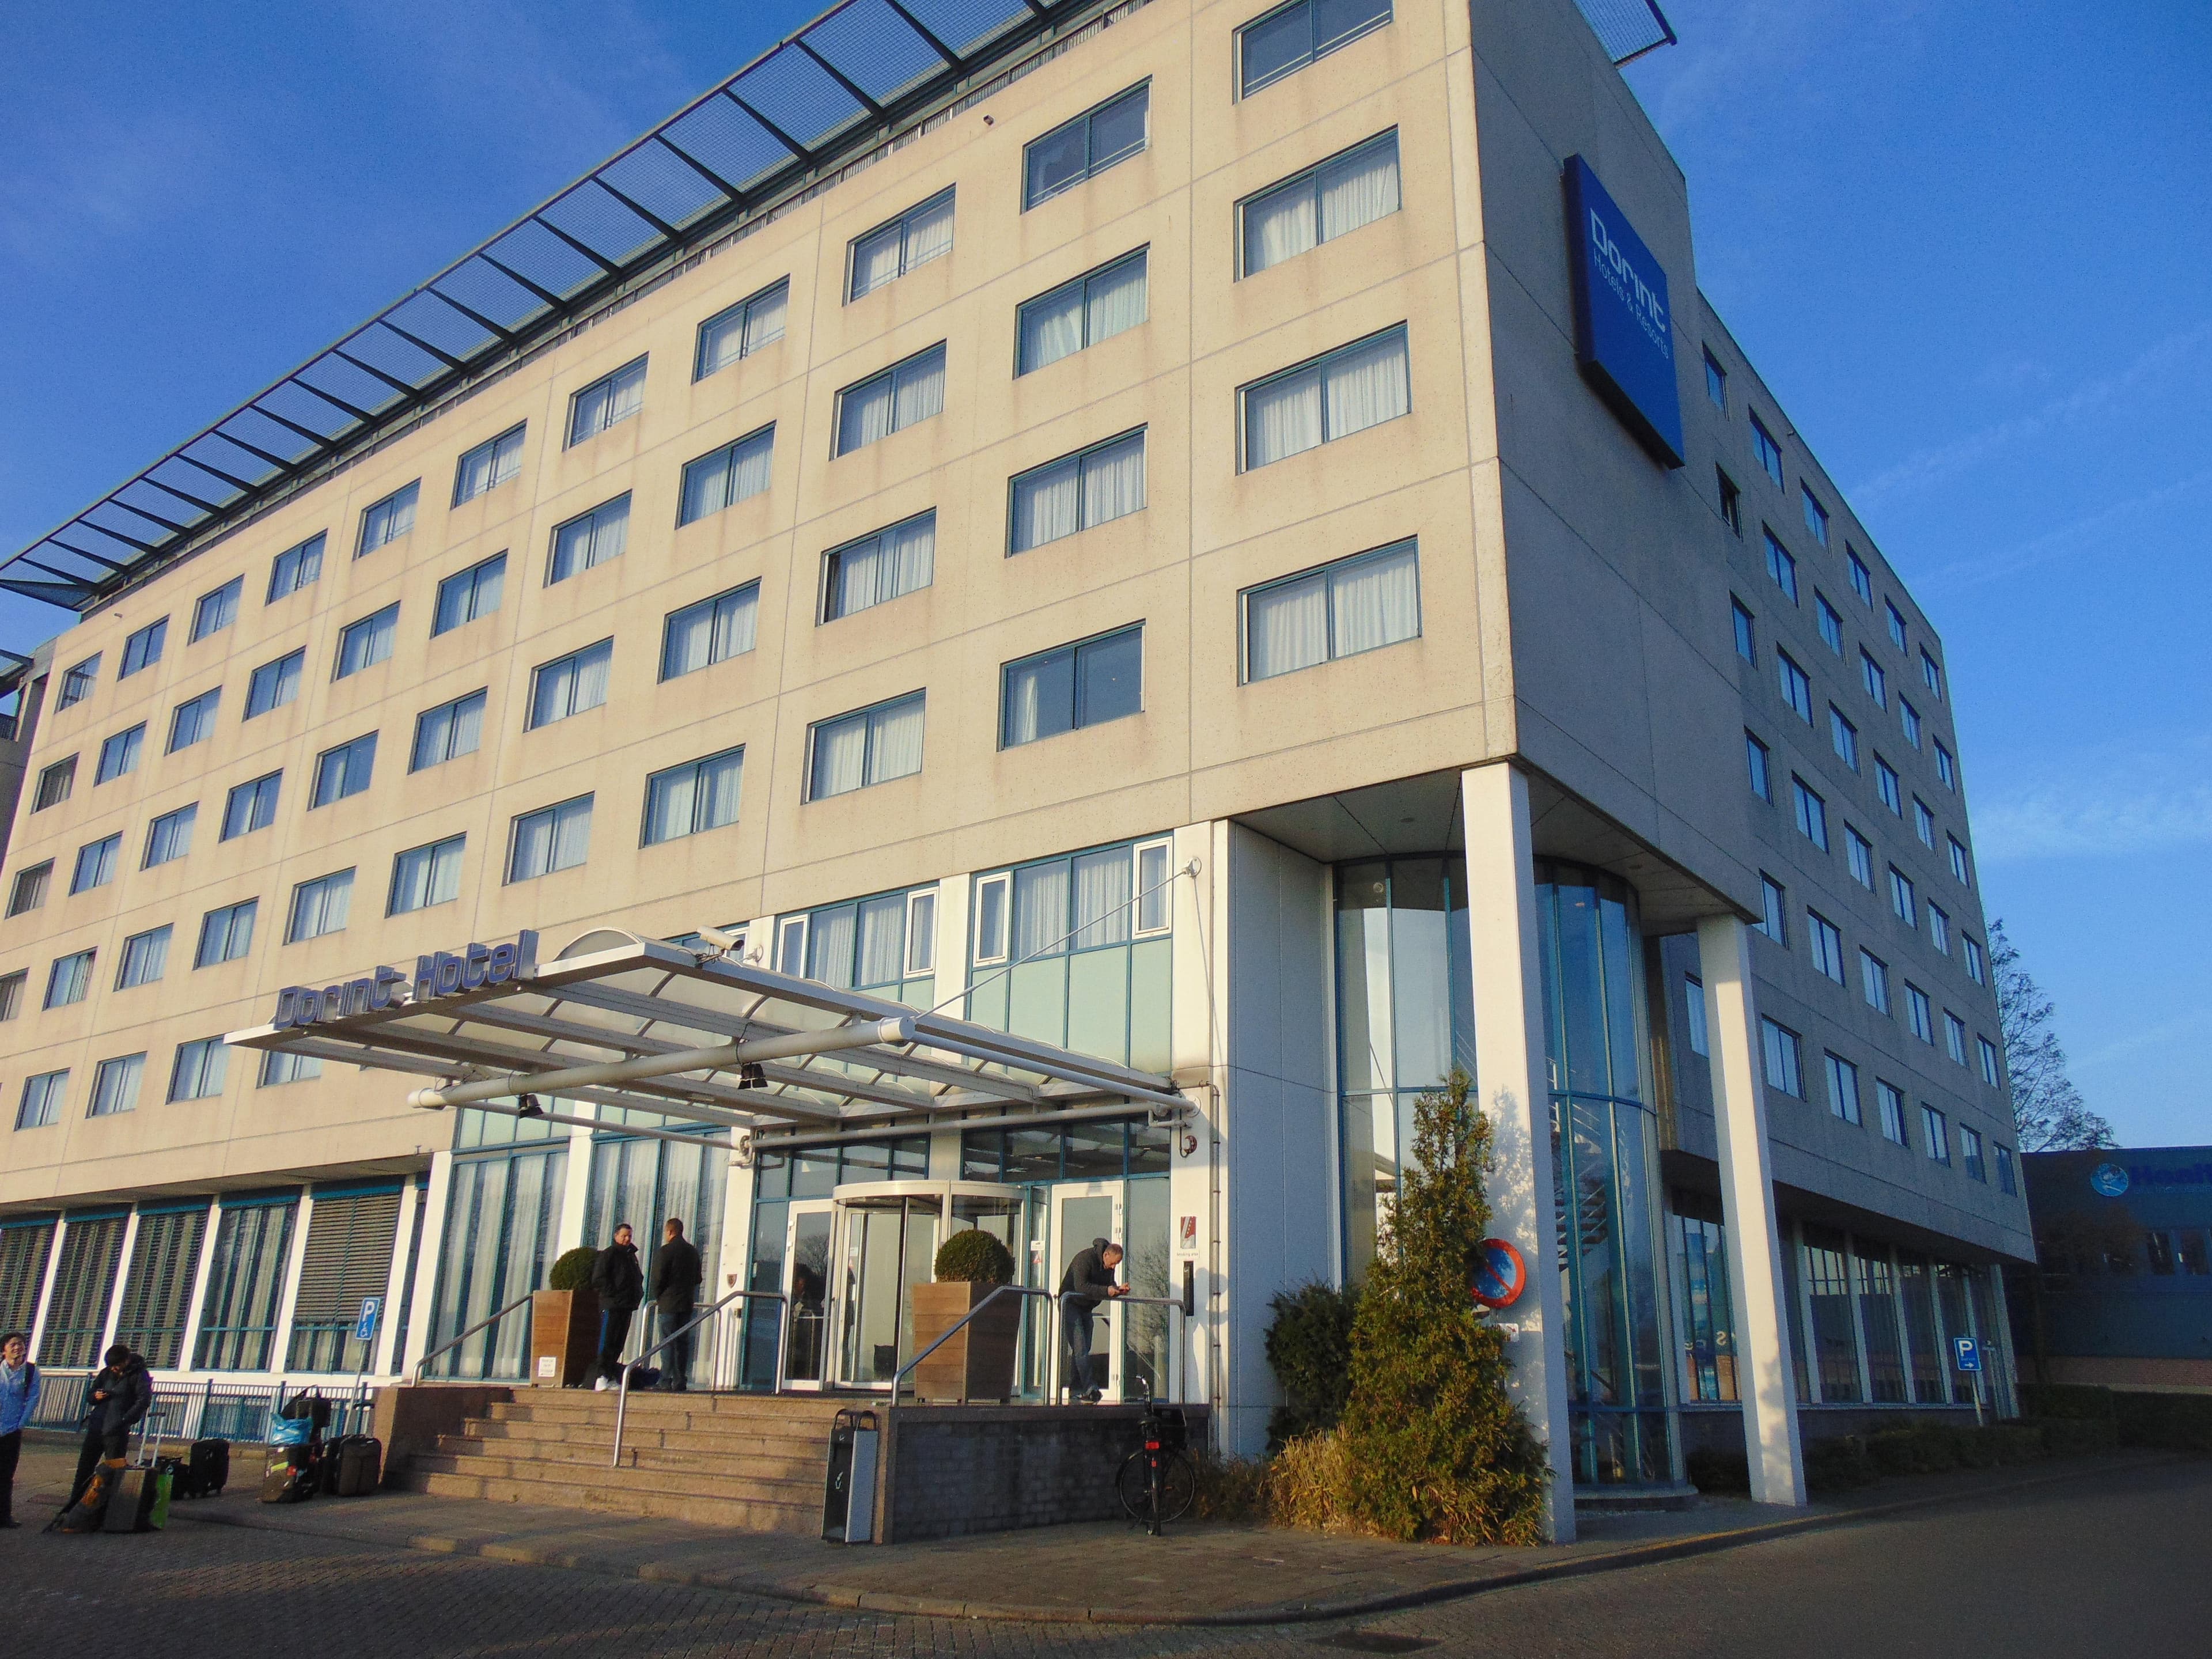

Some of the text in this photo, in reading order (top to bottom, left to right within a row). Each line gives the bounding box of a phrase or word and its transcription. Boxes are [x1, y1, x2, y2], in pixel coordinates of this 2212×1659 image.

[1590, 207, 1666, 333] Dorint
[1593, 248, 1669, 359] Hotels & Resorts
[274, 929, 539, 1031] Dorint Hotel
[362, 1301, 375, 1322] P
[1959, 1340, 1973, 1357] P
